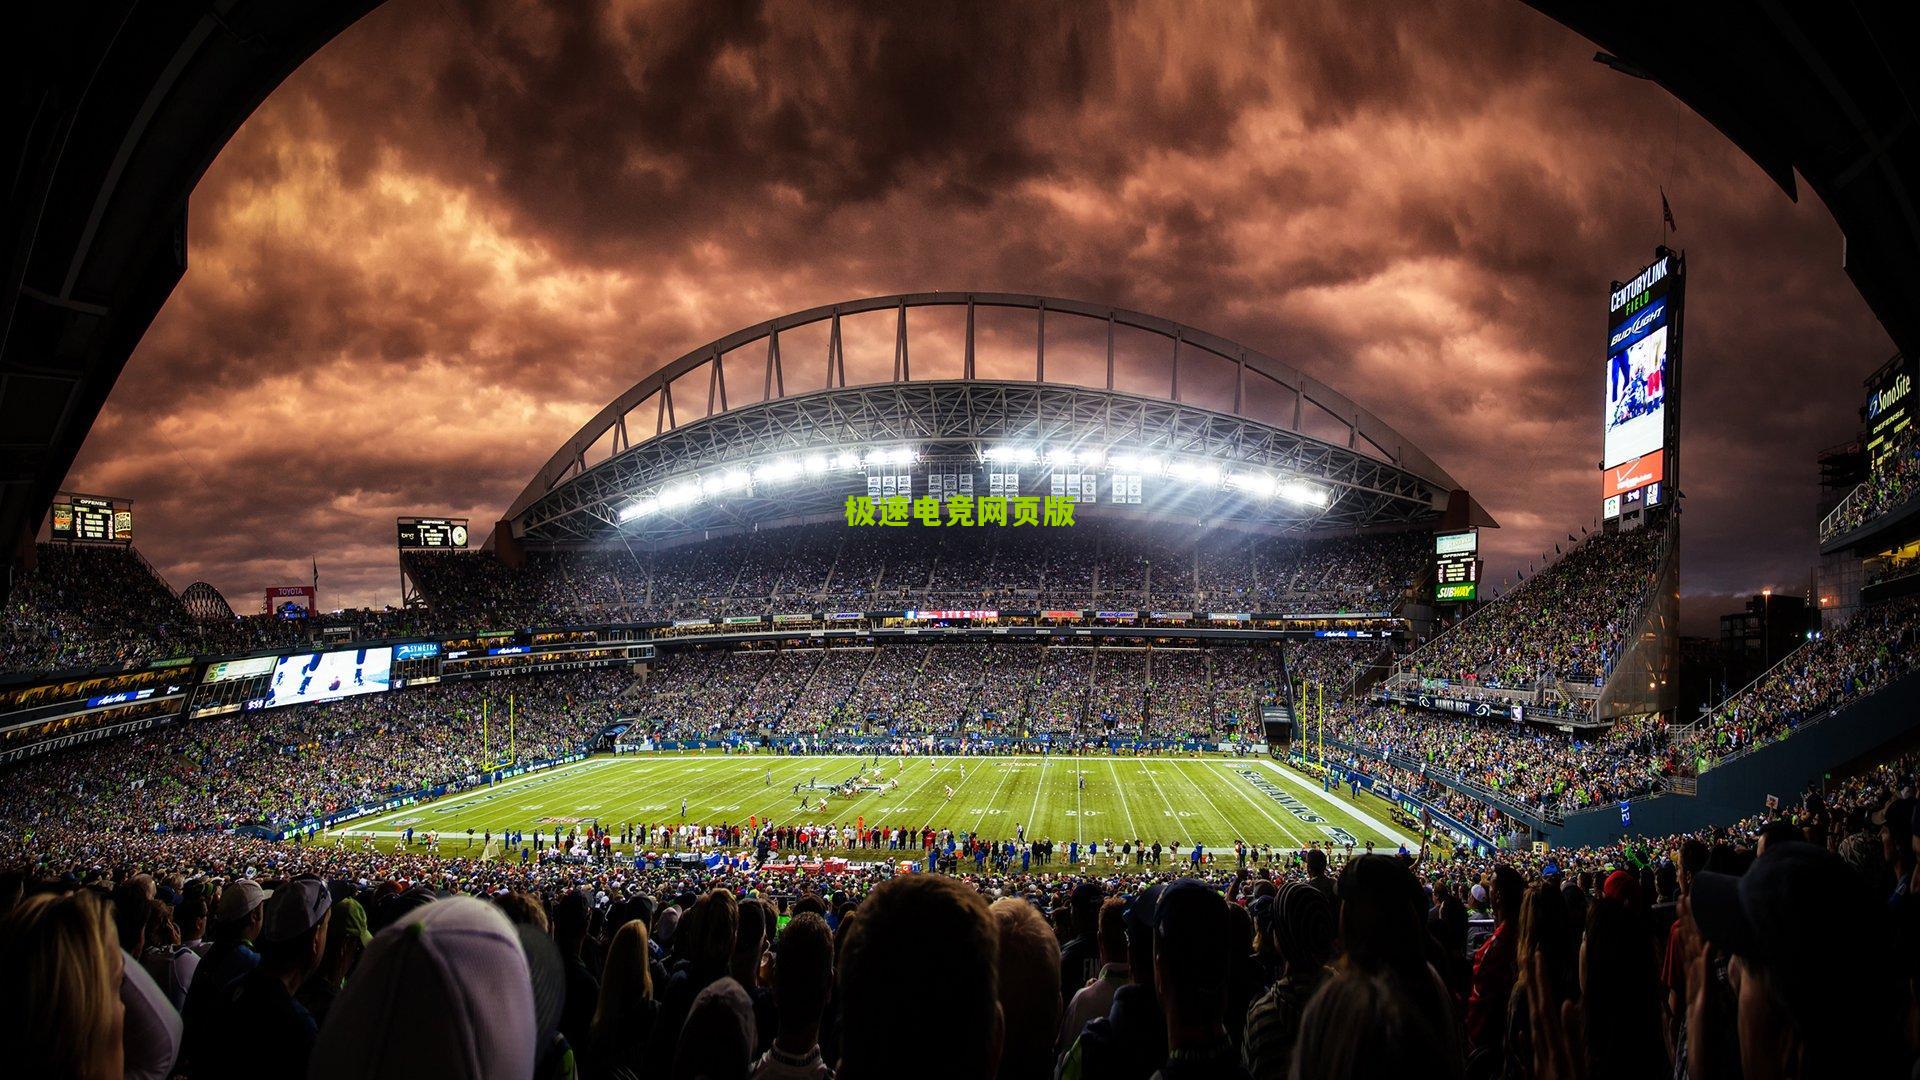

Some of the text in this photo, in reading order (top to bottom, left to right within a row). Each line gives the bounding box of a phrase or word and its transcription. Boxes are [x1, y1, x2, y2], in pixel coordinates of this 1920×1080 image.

[1610, 256, 1668, 313] CENTURYLINK
[1626, 290, 1649, 316] FIELD
[1611, 305, 1665, 346] BUD LIGHT
[1877, 373, 1911, 414] SonoSite
[1873, 407, 1905, 434] DEFENSE
[401, 532, 415, 540] bing
[1437, 585, 1475, 598] SUBWAY
[410, 644, 437, 652] SYMETRA
[490, 667, 516, 677] HOME
[521, 666, 532, 674] OF
[538, 664, 555, 672] THE
[1435, 699, 1455, 709] HAWKS
[9, 751, 24, 762] TO
[30, 728, 112, 756] CENTURYLINK
[118, 720, 153, 735] FIELD
[1621, 806, 1629, 822] 12
